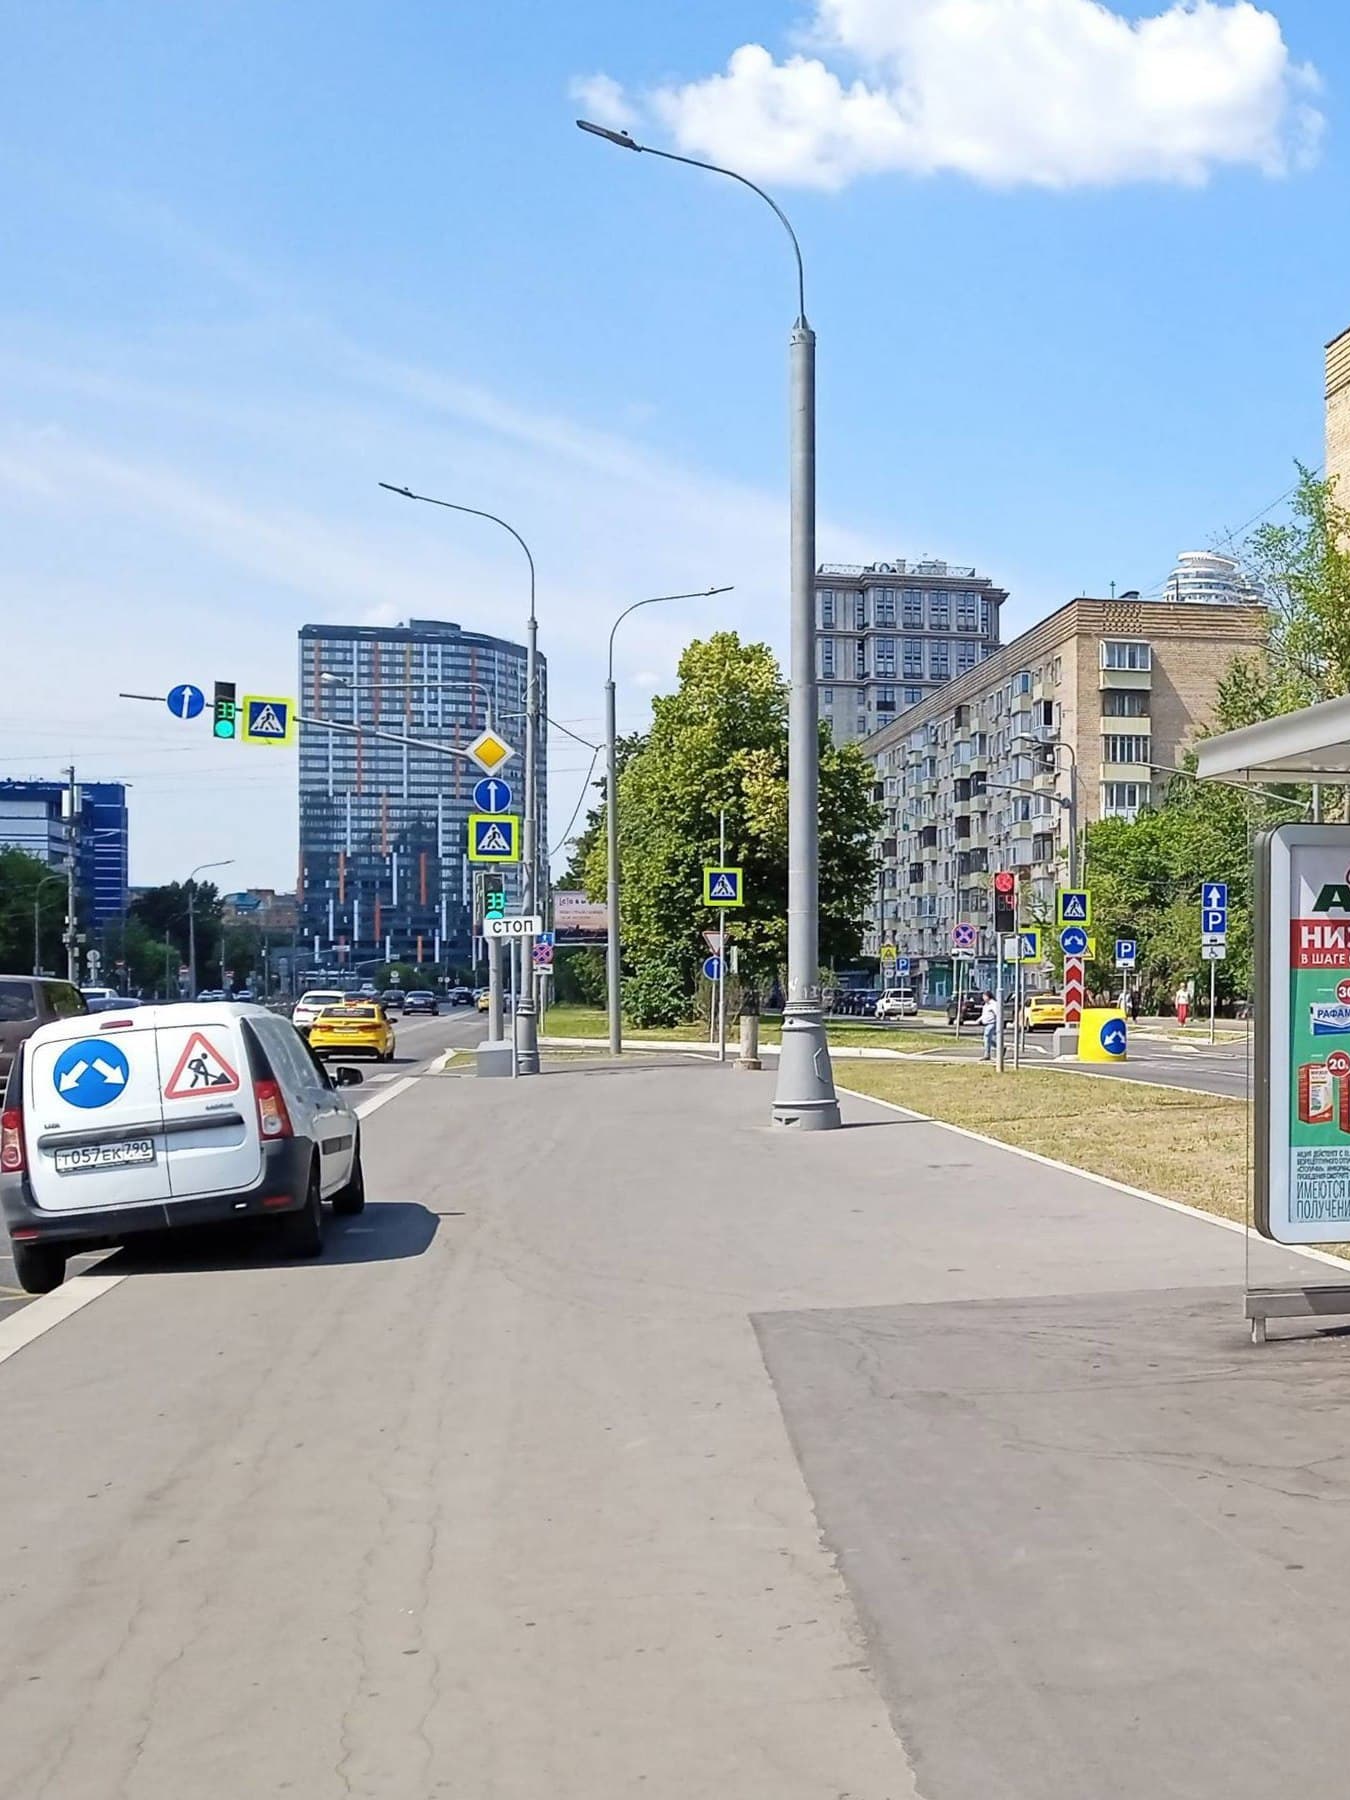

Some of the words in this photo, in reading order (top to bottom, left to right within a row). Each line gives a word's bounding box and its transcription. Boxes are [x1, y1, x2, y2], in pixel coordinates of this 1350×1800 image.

[492, 920, 533, 934] СТОП
[1300, 953, 1308, 964] В
[1311, 953, 1346, 965] ШАГЕ
[1297, 1180, 1345, 1199] ИМЕЮТСЯ
